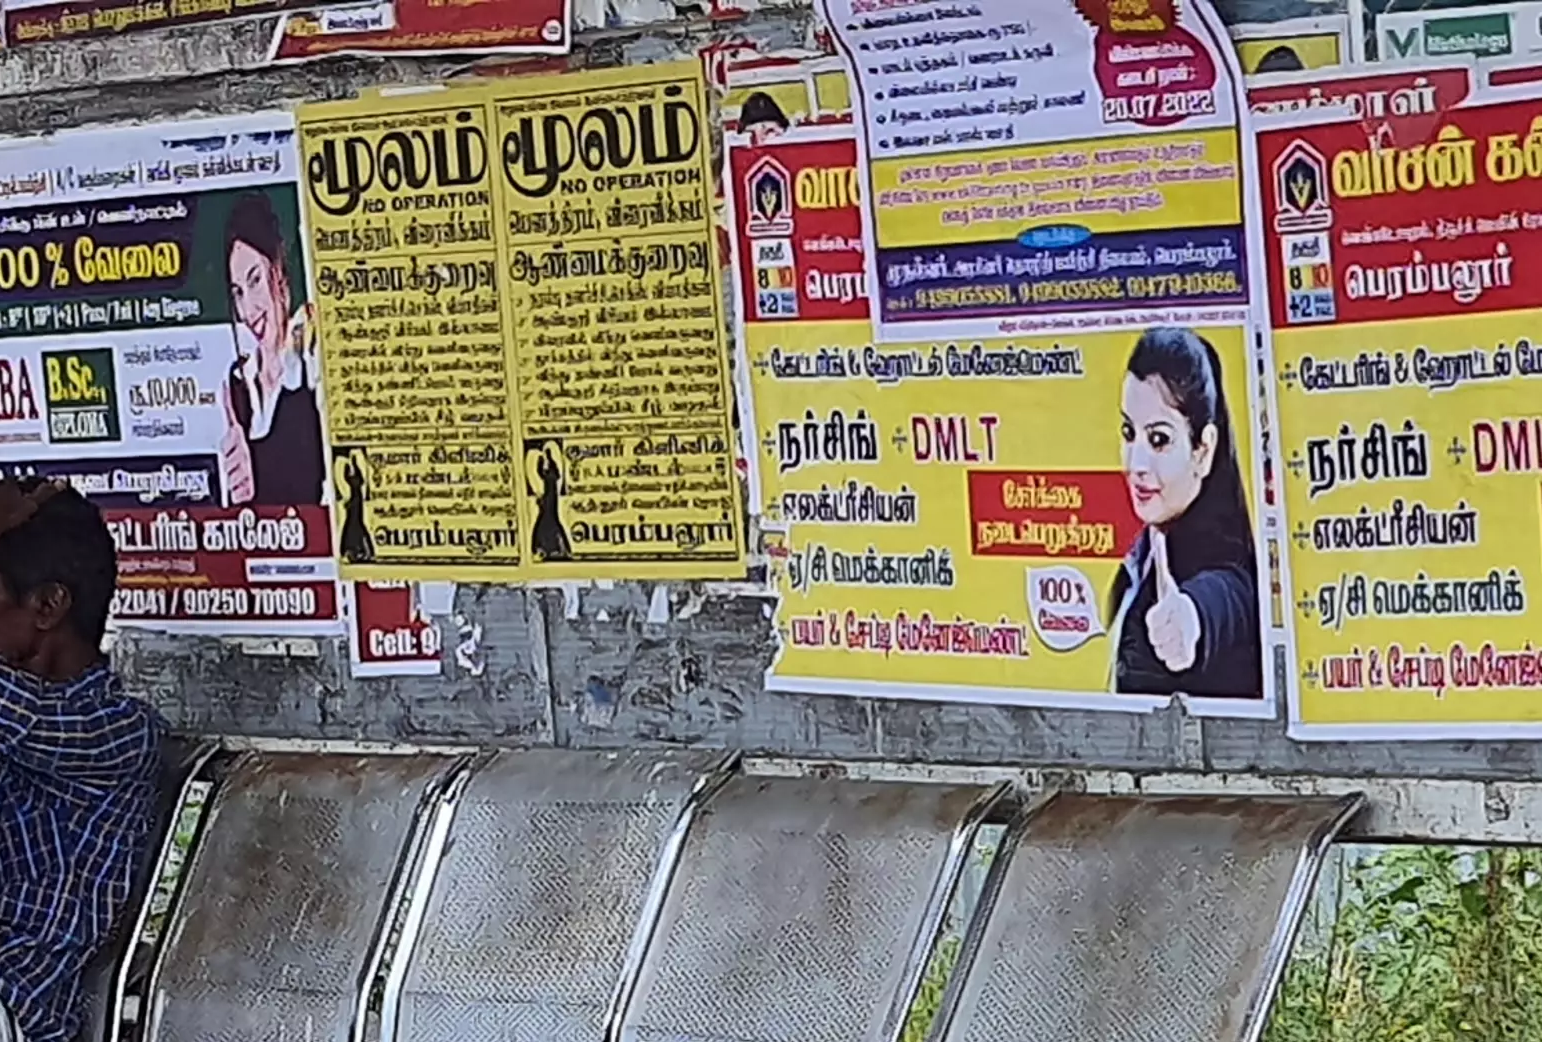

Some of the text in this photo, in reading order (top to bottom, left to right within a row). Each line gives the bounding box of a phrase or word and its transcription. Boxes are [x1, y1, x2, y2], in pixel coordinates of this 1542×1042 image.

[1102, 88, 1216, 123] 20.07.2022
[308, 110, 489, 216] மூலம்
[502, 84, 700, 198] மூலம்
[1331, 122, 1478, 198] வாசன்
[391, 189, 491, 212] OPERATION
[560, 167, 702, 196] NO OPERATION
[45, 241, 70, 290] %
[74, 236, 181, 284] வேலை
[1343, 242, 1515, 305] பெரம்பலூர்
[1299, 351, 1391, 391] கேட்டரிங்
[1393, 352, 1411, 388] &
[1412, 349, 1510, 395] ஹோட்டல்
[778, 409, 998, 472] நர்சிங் DMLT
[1307, 417, 1430, 498] நர்சிங்
[203, 505, 306, 551] காலேஜ்
[374, 519, 516, 556] பெரம்பலூர்
[570, 510, 734, 552] பெரம்பலூர்
[183, 587, 248, 615] 90250
[252, 586, 316, 615] 70090
[1037, 575, 1073, 605] 100
[1371, 568, 1525, 616] மெக்கானிக்
[1321, 645, 1364, 692] பயர்
[1367, 655, 1384, 690] &
